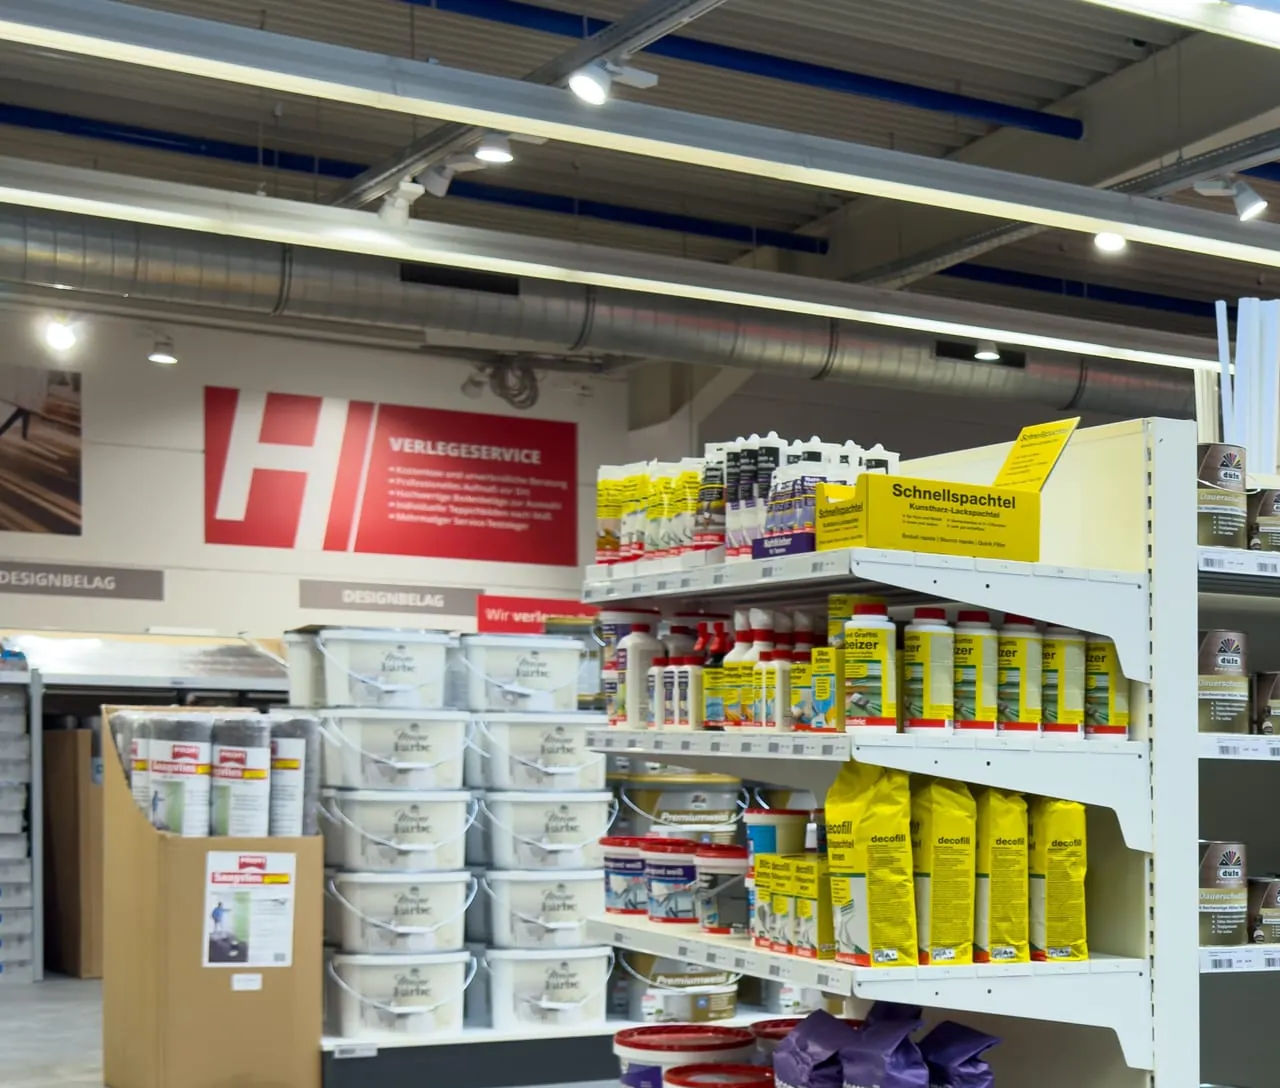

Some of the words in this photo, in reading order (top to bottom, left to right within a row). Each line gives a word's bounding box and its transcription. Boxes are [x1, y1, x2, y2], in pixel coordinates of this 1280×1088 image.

[388, 437, 542, 465] VERLEGESERVICE
[892, 483, 1016, 510] Schnellspachtel
[909, 502, 1000, 519] Kunstharz-Lackspachtel
[0, 570, 116, 590] DESIGNBELAG
[342, 589, 445, 608] DESIGNBELAG
[485, 608, 508, 622] Wir
[871, 834, 906, 843] decofill
[937, 836, 970, 845] decofill
[995, 837, 1025, 846] decofill
[1051, 839, 1082, 848] decofill
